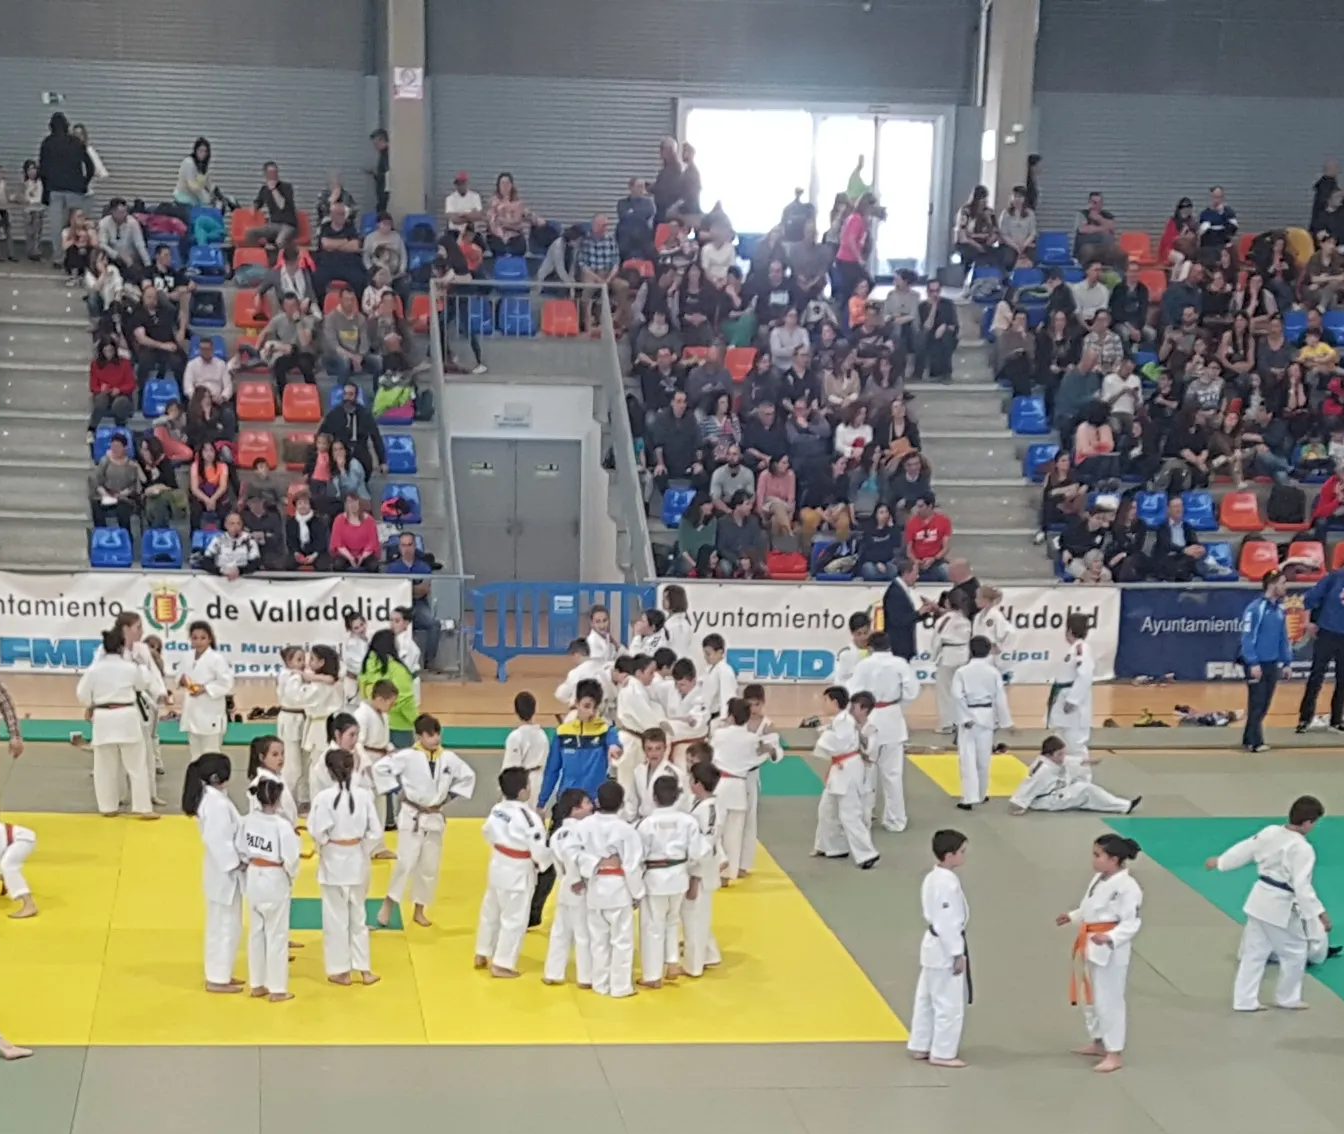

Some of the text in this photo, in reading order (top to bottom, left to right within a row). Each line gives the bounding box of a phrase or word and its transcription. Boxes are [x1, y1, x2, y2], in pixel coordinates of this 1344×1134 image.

[206, 595, 391, 622] de Valladolid
[692, 604, 845, 633] yuntamiento
[726, 647, 836, 680] FMD
